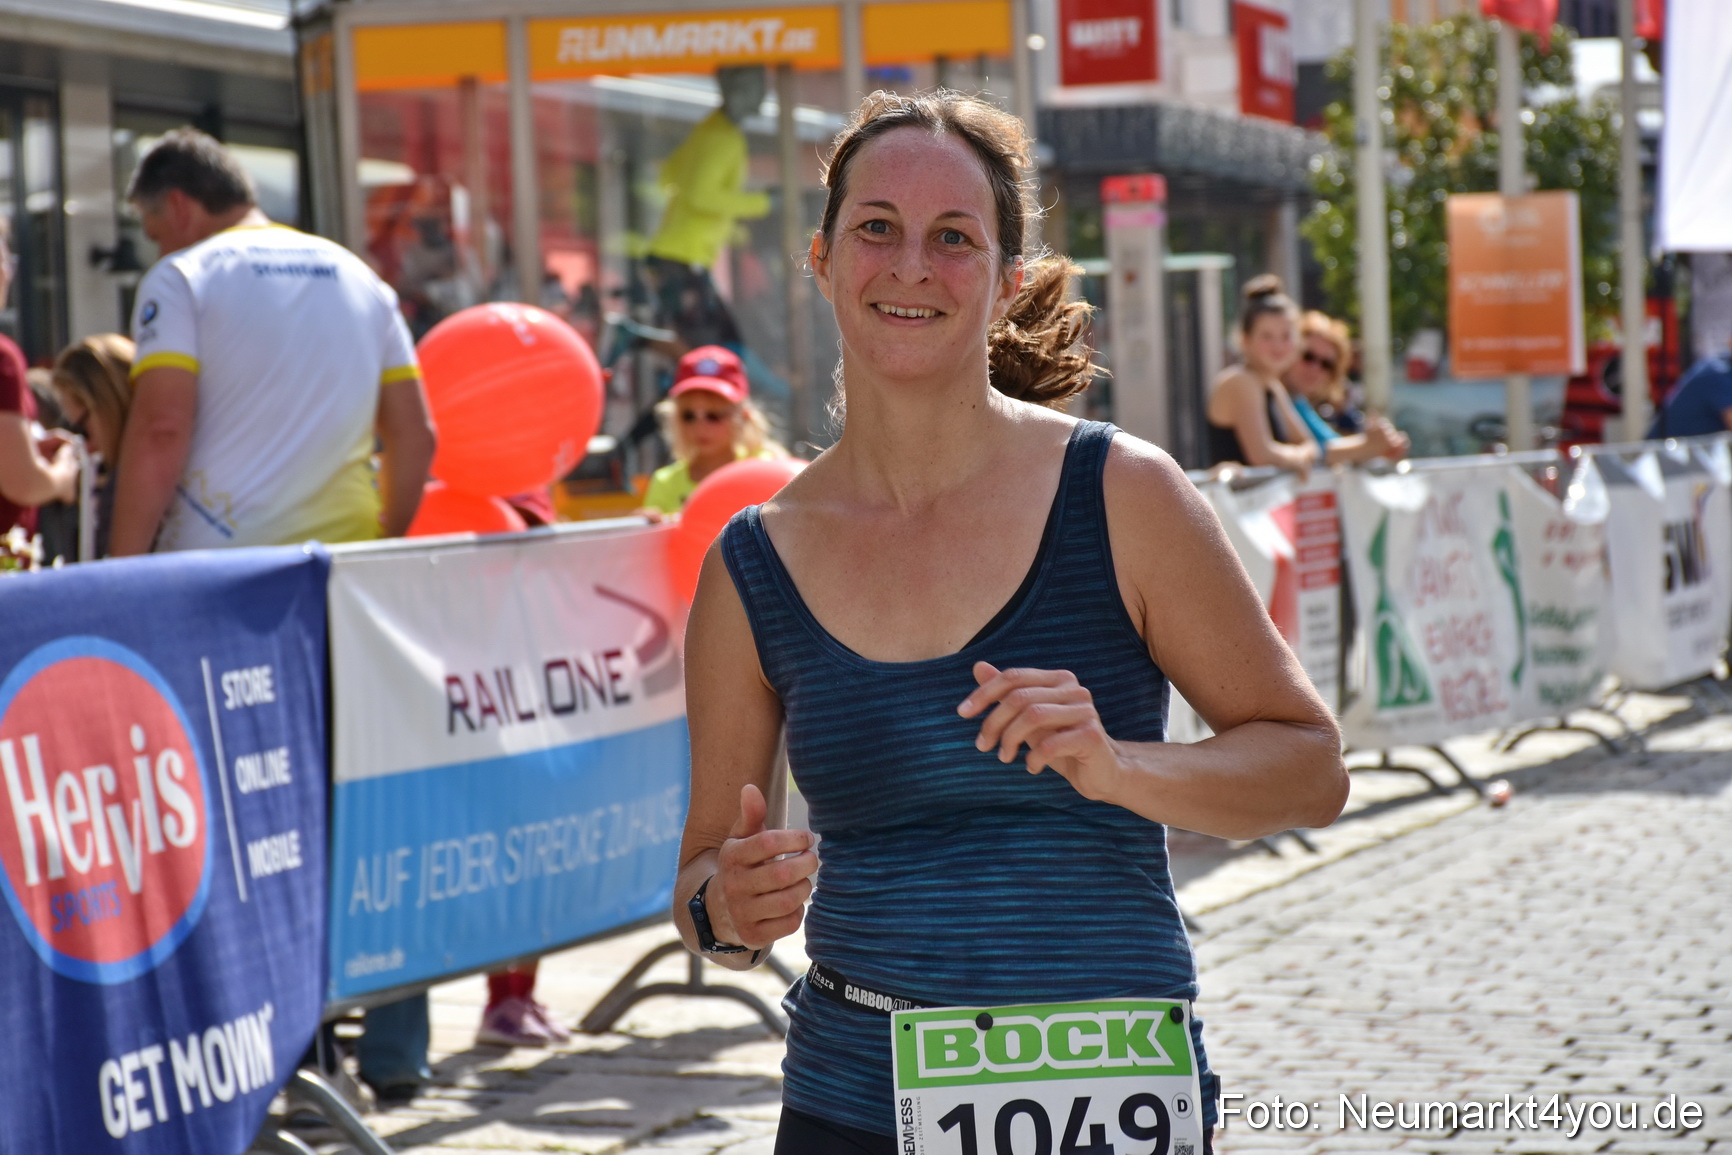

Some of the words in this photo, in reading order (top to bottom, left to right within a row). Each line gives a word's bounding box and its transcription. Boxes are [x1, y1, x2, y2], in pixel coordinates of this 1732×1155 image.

[221, 664, 275, 710] STORE
[234, 746, 292, 795] ONLINE
[0, 723, 197, 895] Hervis
[247, 829, 302, 880] MOBILE
[348, 847, 412, 917] AUF
[416, 832, 498, 909] JEDER
[51, 880, 122, 933] SPORTS
[918, 1012, 1171, 1077] BOCK
[98, 1042, 169, 1139] GET
[1177, 1099, 1188, 1113] D
[936, 1092, 1171, 1155] 1049
